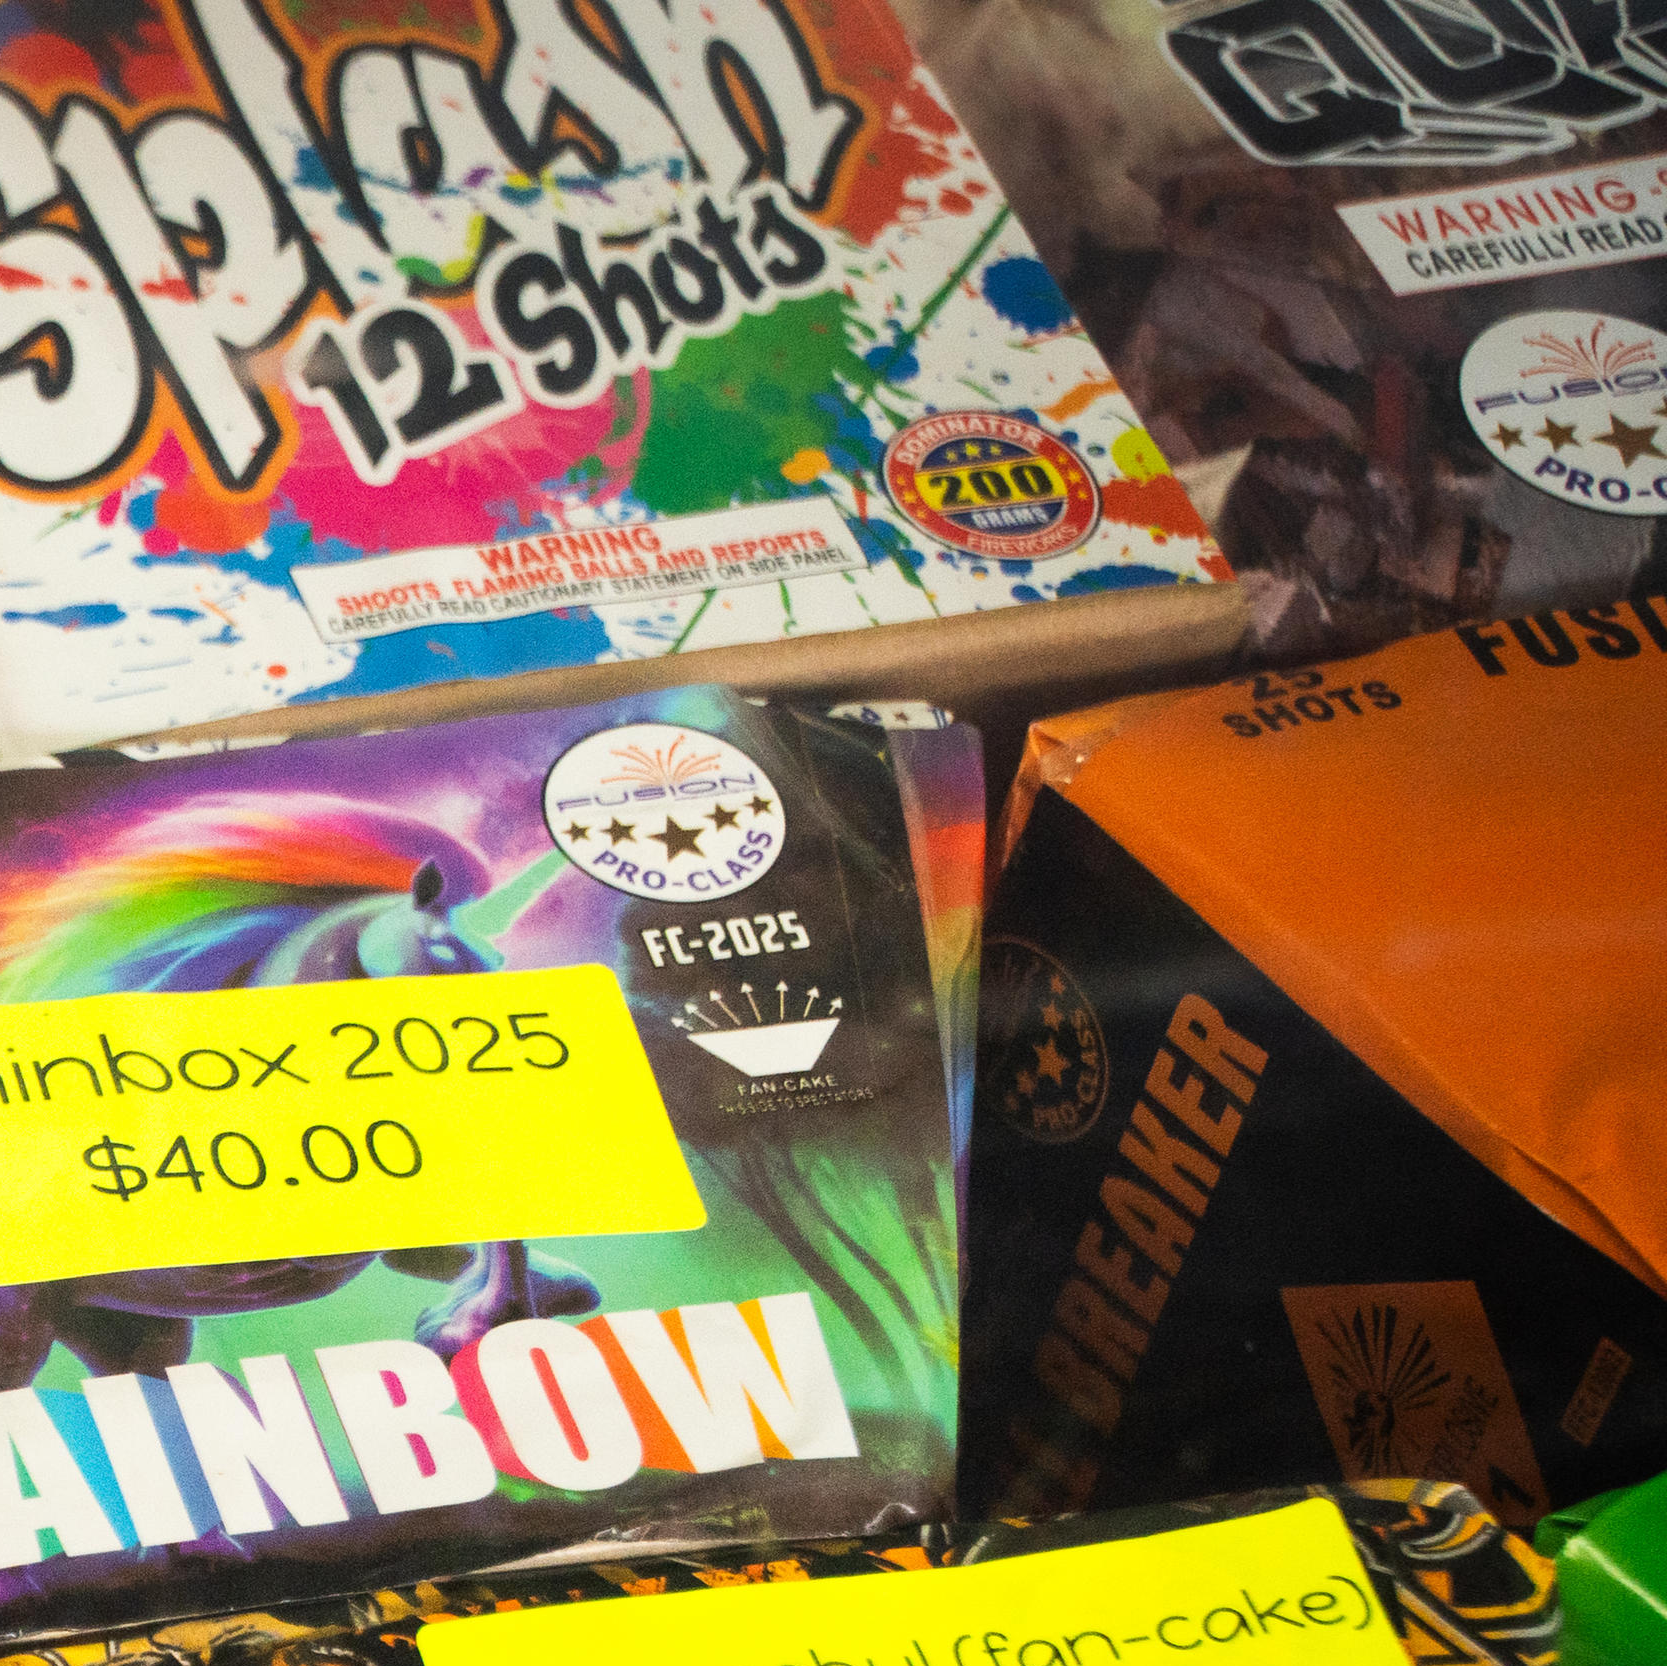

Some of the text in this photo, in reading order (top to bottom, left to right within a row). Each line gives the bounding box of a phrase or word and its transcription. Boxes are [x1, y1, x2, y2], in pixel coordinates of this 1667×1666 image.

[1378, 178, 1637, 246] WARNING
[1406, 214, 1663, 279] CAREFULLY READ
[301, 192, 828, 468] 12 Shots
[895, 416, 1043, 466] DOMINATOR
[928, 463, 1054, 508] 200
[338, 530, 828, 615] SHOOTS FLAMING BALLS AND REPORTS
[476, 525, 661, 575] WARNING
[328, 600, 435, 636] CAREFULLY
[438, 596, 485, 621] READ
[488, 579, 610, 615] CAUTIONARY
[612, 567, 712, 597] STATEMENT
[747, 559, 783, 579] SIDE
[787, 547, 853, 574] PANEL
[1222, 681, 1403, 738] SHOTS
[555, 772, 758, 813] FUSION
[592, 828, 773, 893] PRO-CLASS
[641, 910, 810, 968] FC-2025
[328, 1010, 570, 1082] 2025
[82, 1118, 425, 1204] $40.00
[1033, 992, 1271, 1435] BREAKER
